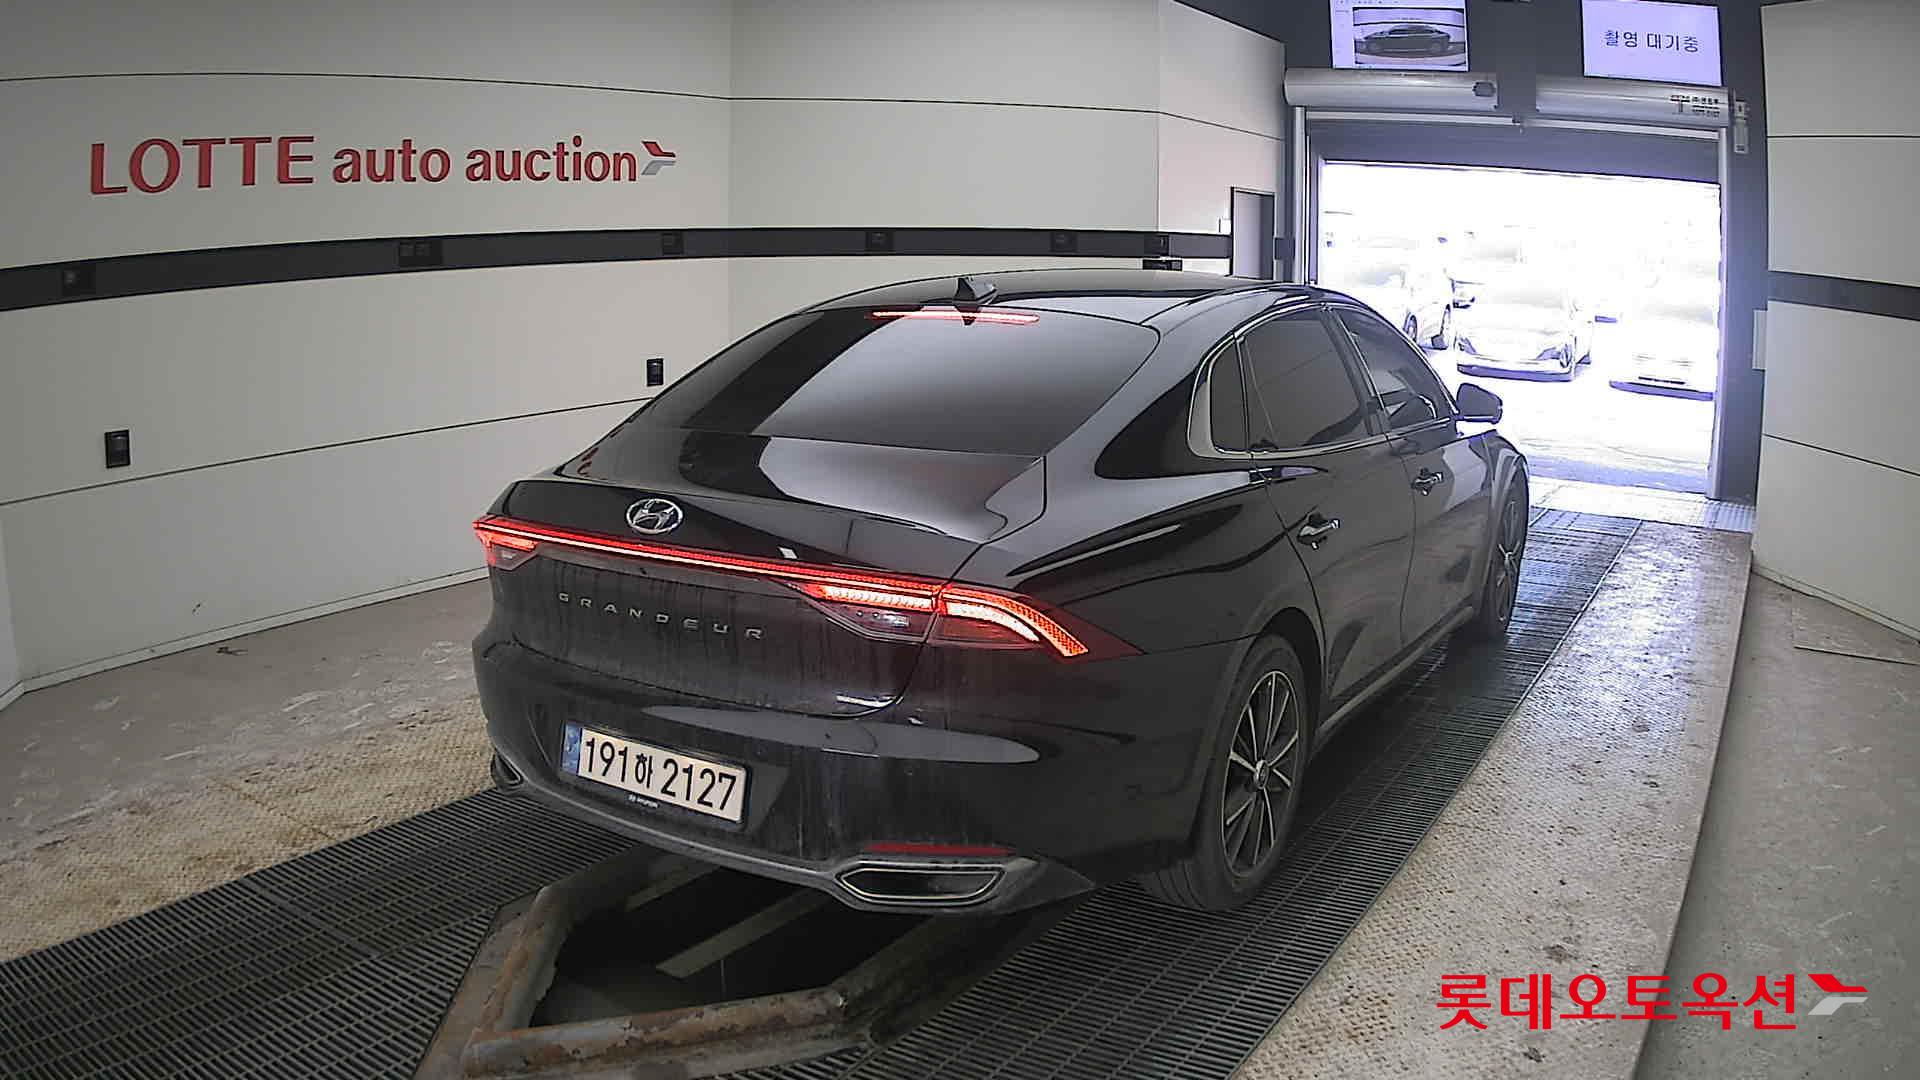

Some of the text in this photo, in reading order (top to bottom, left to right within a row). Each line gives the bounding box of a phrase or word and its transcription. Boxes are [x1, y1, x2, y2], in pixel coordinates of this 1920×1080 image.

[1604, 30, 1699, 52] 촬영 대기중
[90, 135, 637, 195] LOTTE auto auction
[558, 592, 763, 640] GRANDEUR
[660, 758, 737, 811] 2127
